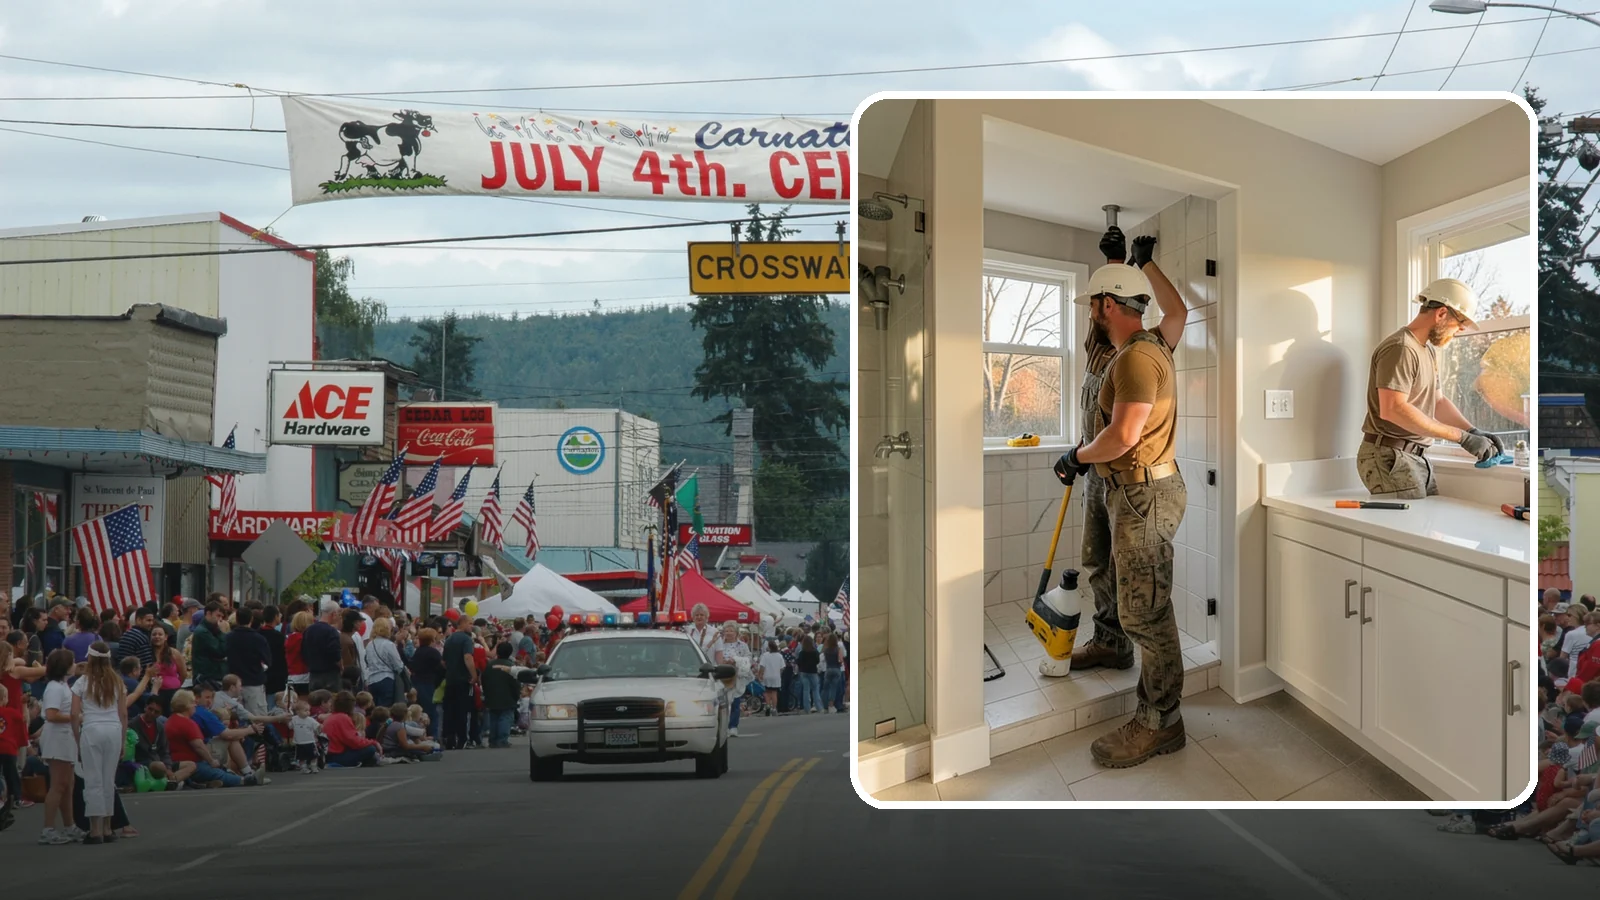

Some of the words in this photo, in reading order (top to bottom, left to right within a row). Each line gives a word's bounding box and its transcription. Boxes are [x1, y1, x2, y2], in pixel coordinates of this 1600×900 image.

[481, 141, 604, 192] JULY
[632, 150, 746, 198] 4th.
[697, 254, 850, 280] CROSSWA
[283, 380, 373, 420] ACE
[406, 409, 453, 422] CEDAR
[461, 409, 485, 422] LOG
[283, 421, 371, 437] Hardware
[416, 428, 477, 447] Coca-Cola
[353, 466, 387, 479] Simpl
[96, 485, 124, 495] Vincent
[126, 486, 136, 495] de
[137, 485, 155, 495] Paul
[81, 503, 153, 522] THT
[688, 526, 741, 535] CRNATION
[699, 535, 730, 544] GLASS
